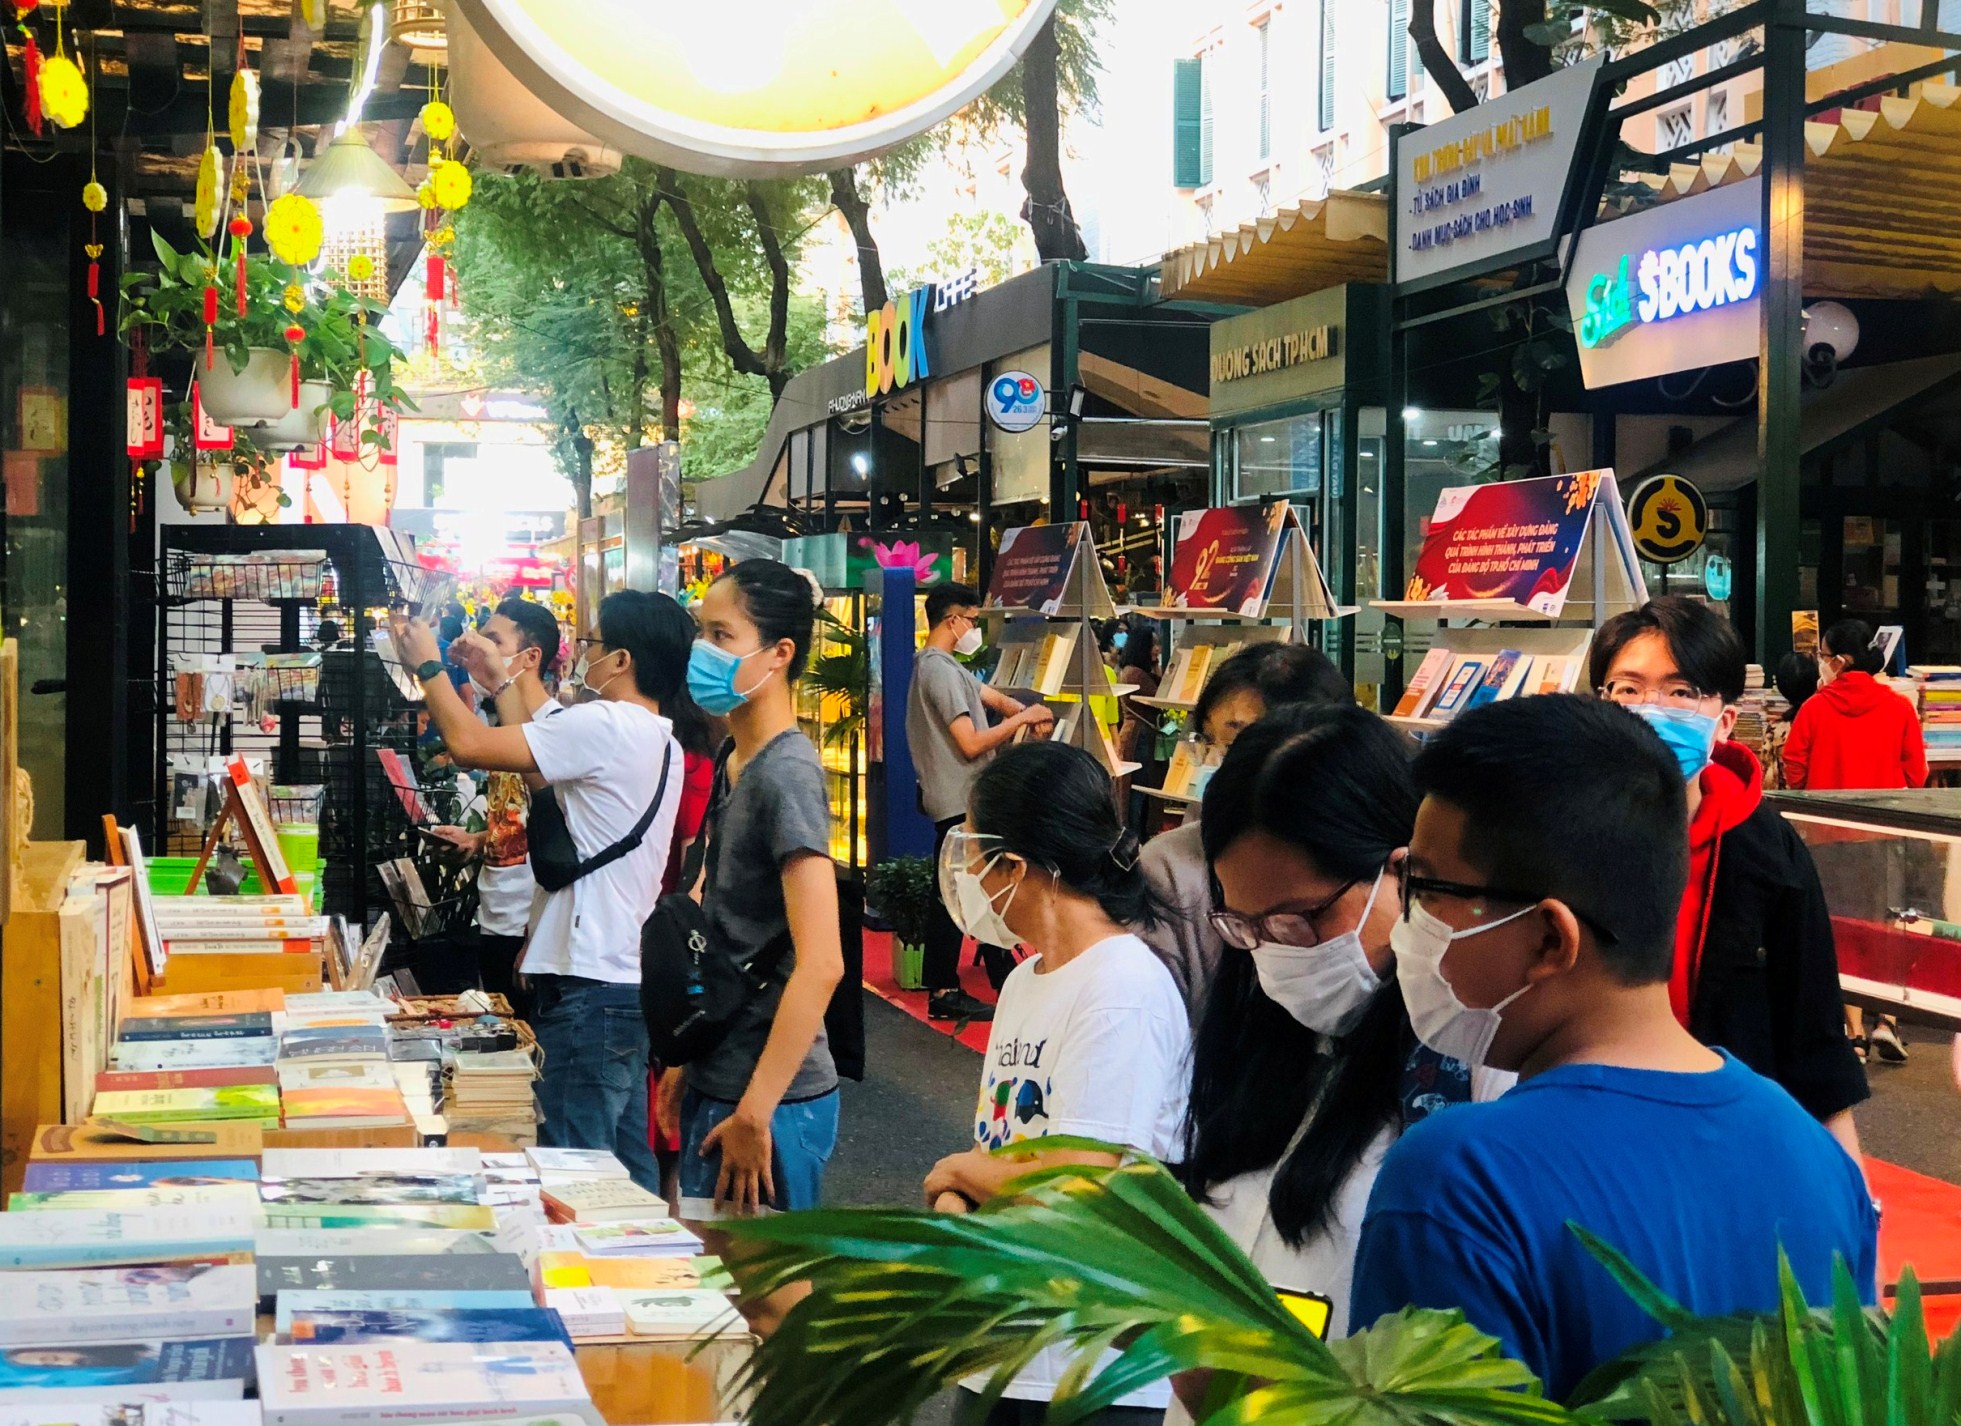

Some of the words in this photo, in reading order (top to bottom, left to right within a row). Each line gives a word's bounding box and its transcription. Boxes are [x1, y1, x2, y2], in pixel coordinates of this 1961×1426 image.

[1425, 186, 1444, 211] SÁCH
[1447, 182, 1459, 203] GIA
[1475, 208, 1490, 231] CHO
[866, 284, 931, 398] BOOK
